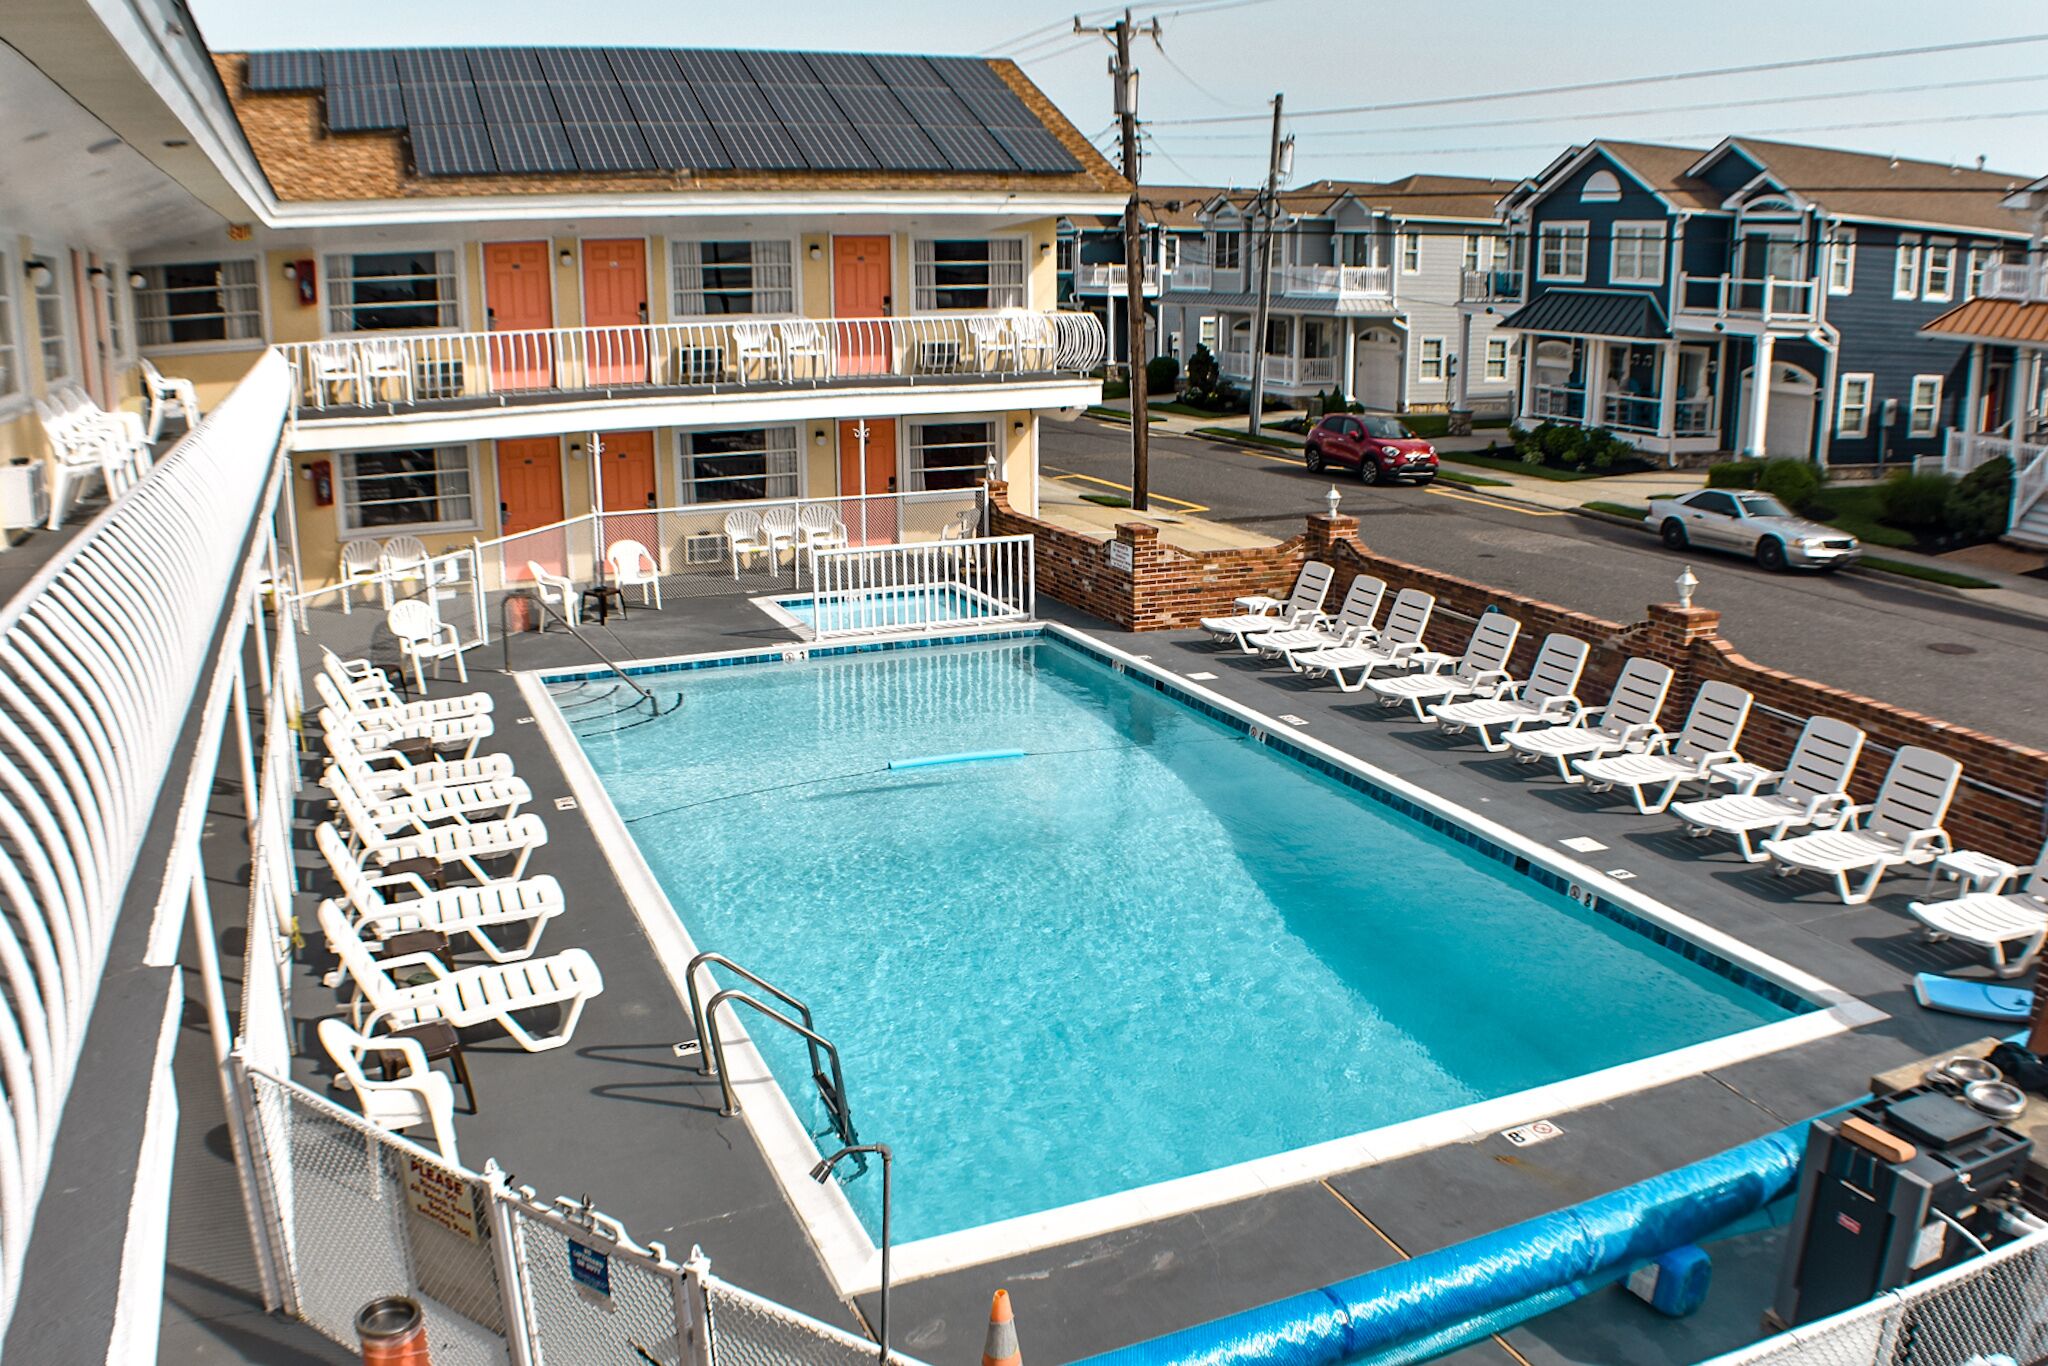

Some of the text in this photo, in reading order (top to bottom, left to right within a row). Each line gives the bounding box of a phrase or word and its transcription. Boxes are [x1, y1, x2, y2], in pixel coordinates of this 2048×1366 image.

[1583, 892, 1593, 908] 8
[679, 1042, 697, 1050] 8
[410, 1160, 465, 1197] PLEASE
[422, 1188, 449, 1207] Beach
[451, 1203, 472, 1220] Sand
[572, 1249, 605, 1270] LIFEGUARD
[585, 1262, 602, 1276] DUTY
